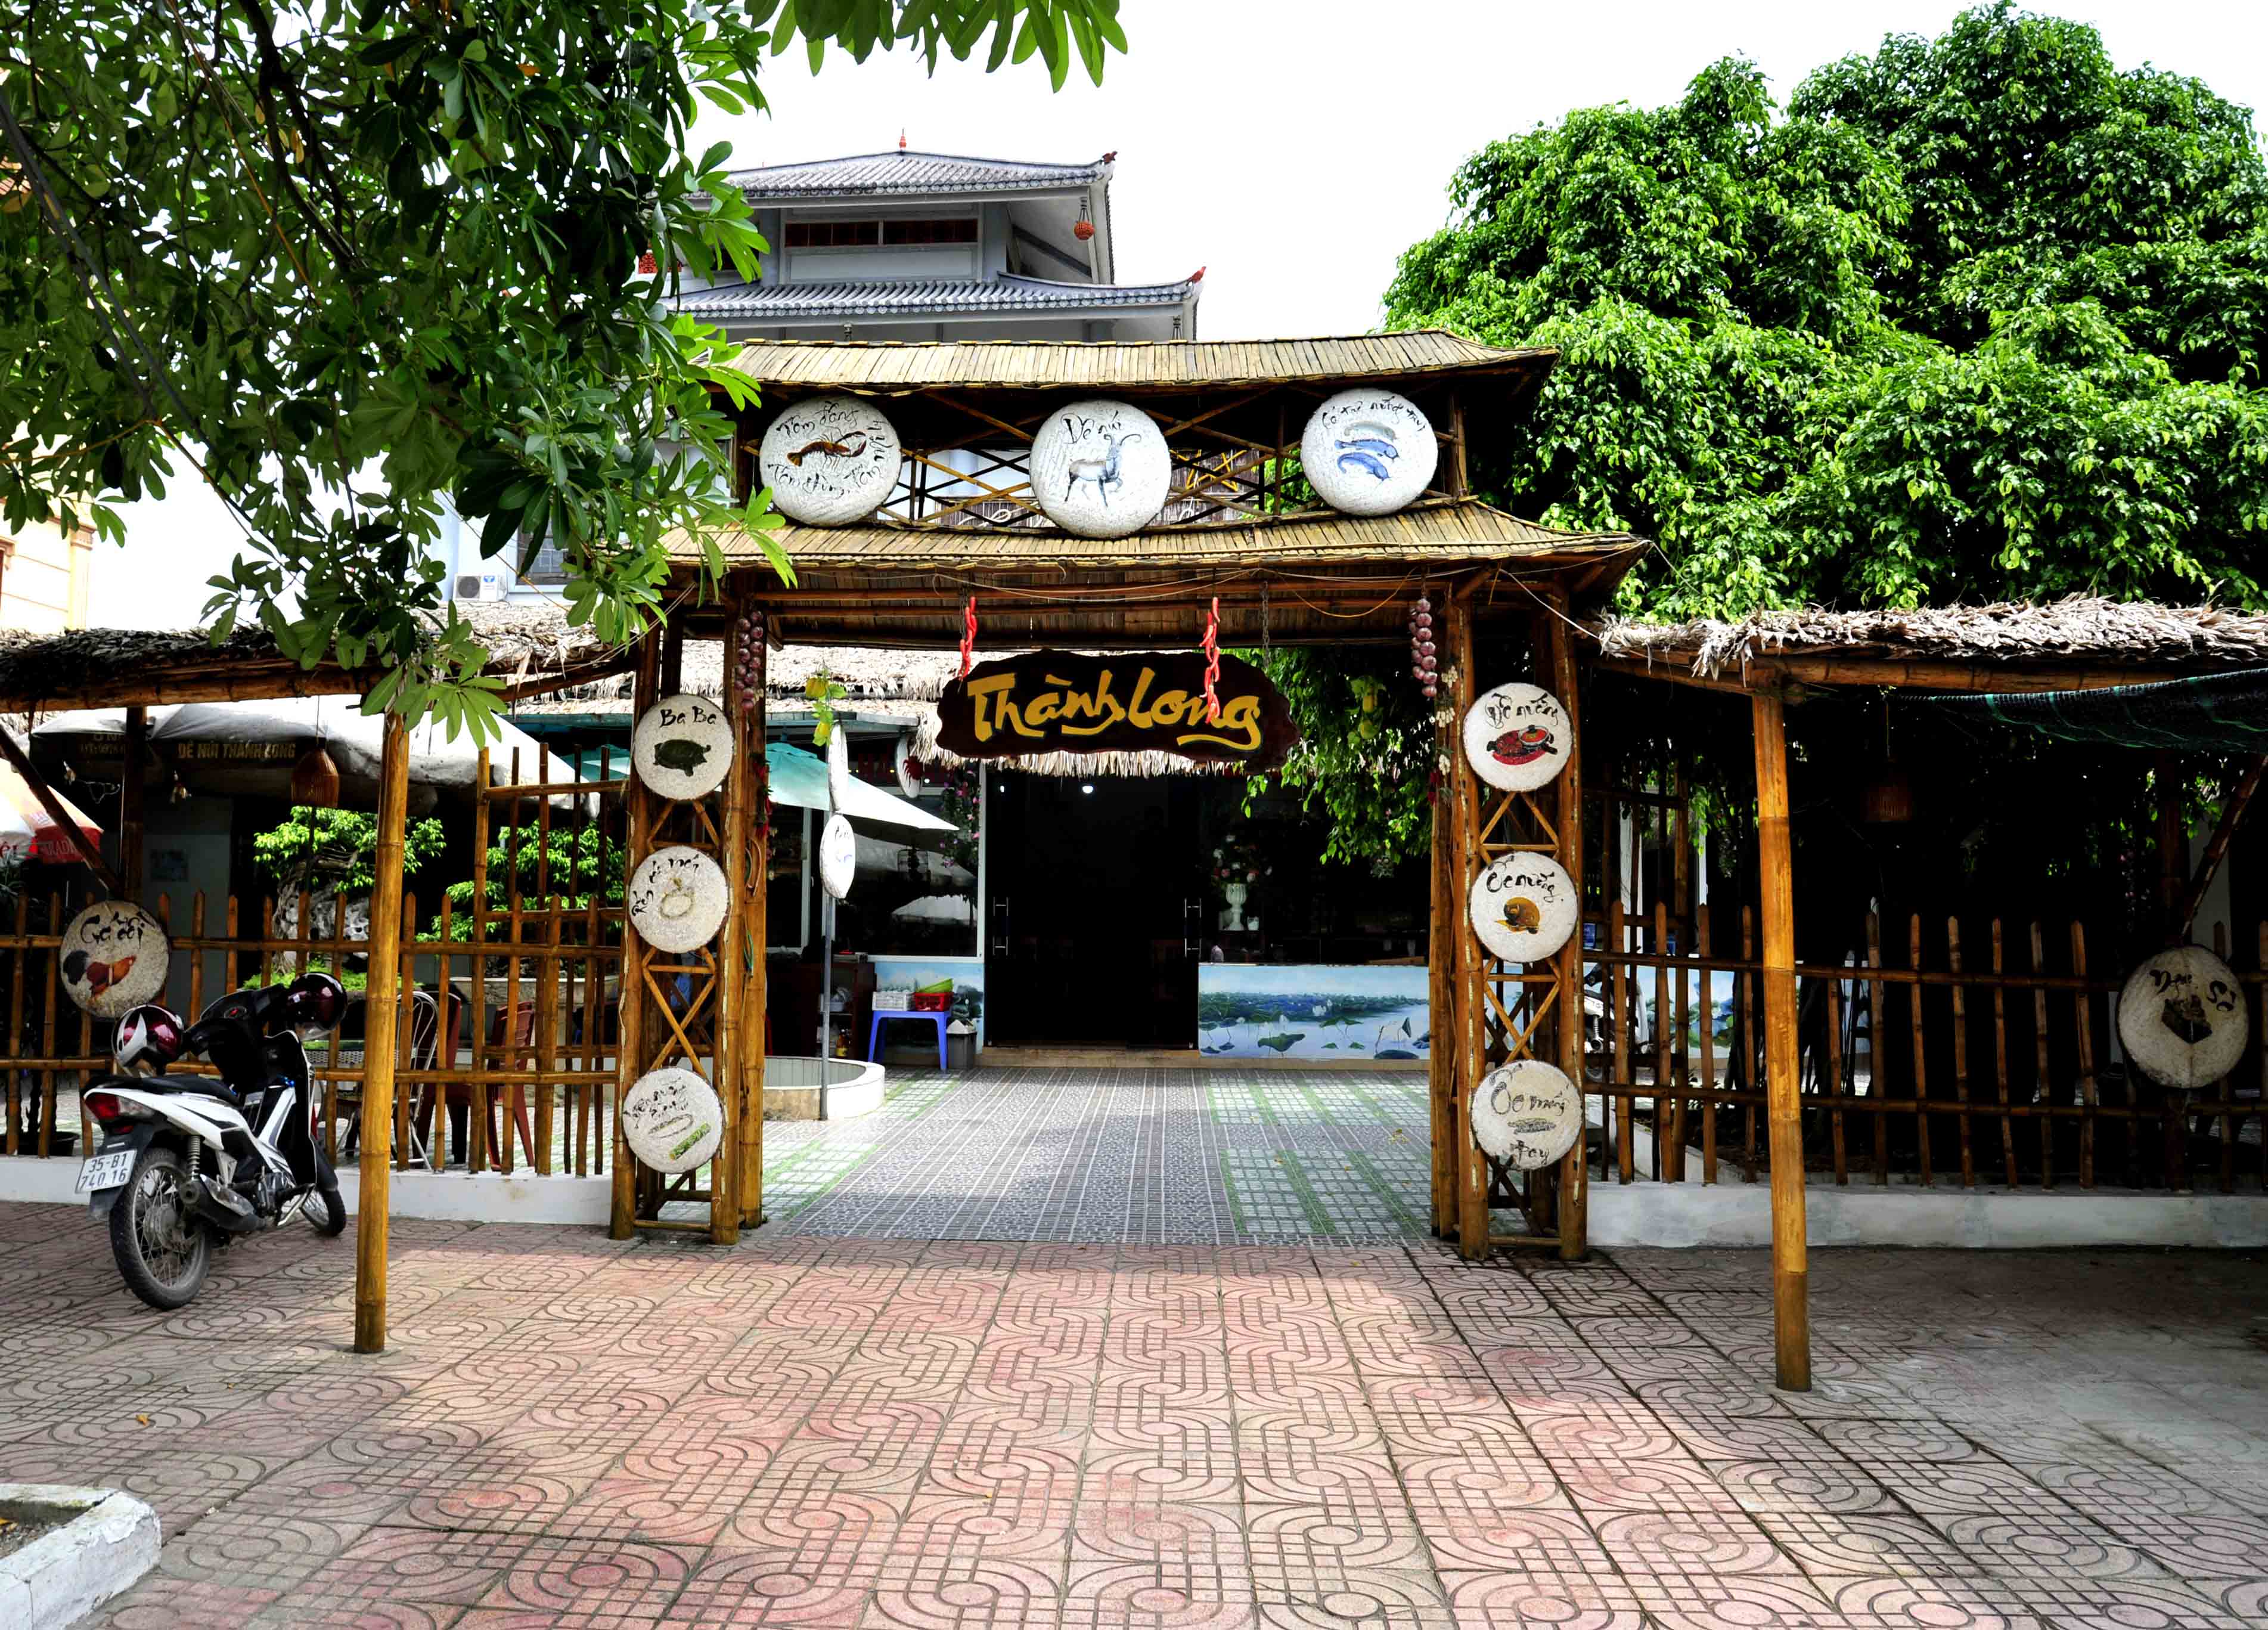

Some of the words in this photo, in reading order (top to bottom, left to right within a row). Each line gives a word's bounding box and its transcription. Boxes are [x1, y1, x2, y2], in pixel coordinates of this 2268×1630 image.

[660, 709, 686, 728] Ba
[692, 706, 717, 724] Ba
[89, 1153, 128, 1173] 35-B1
